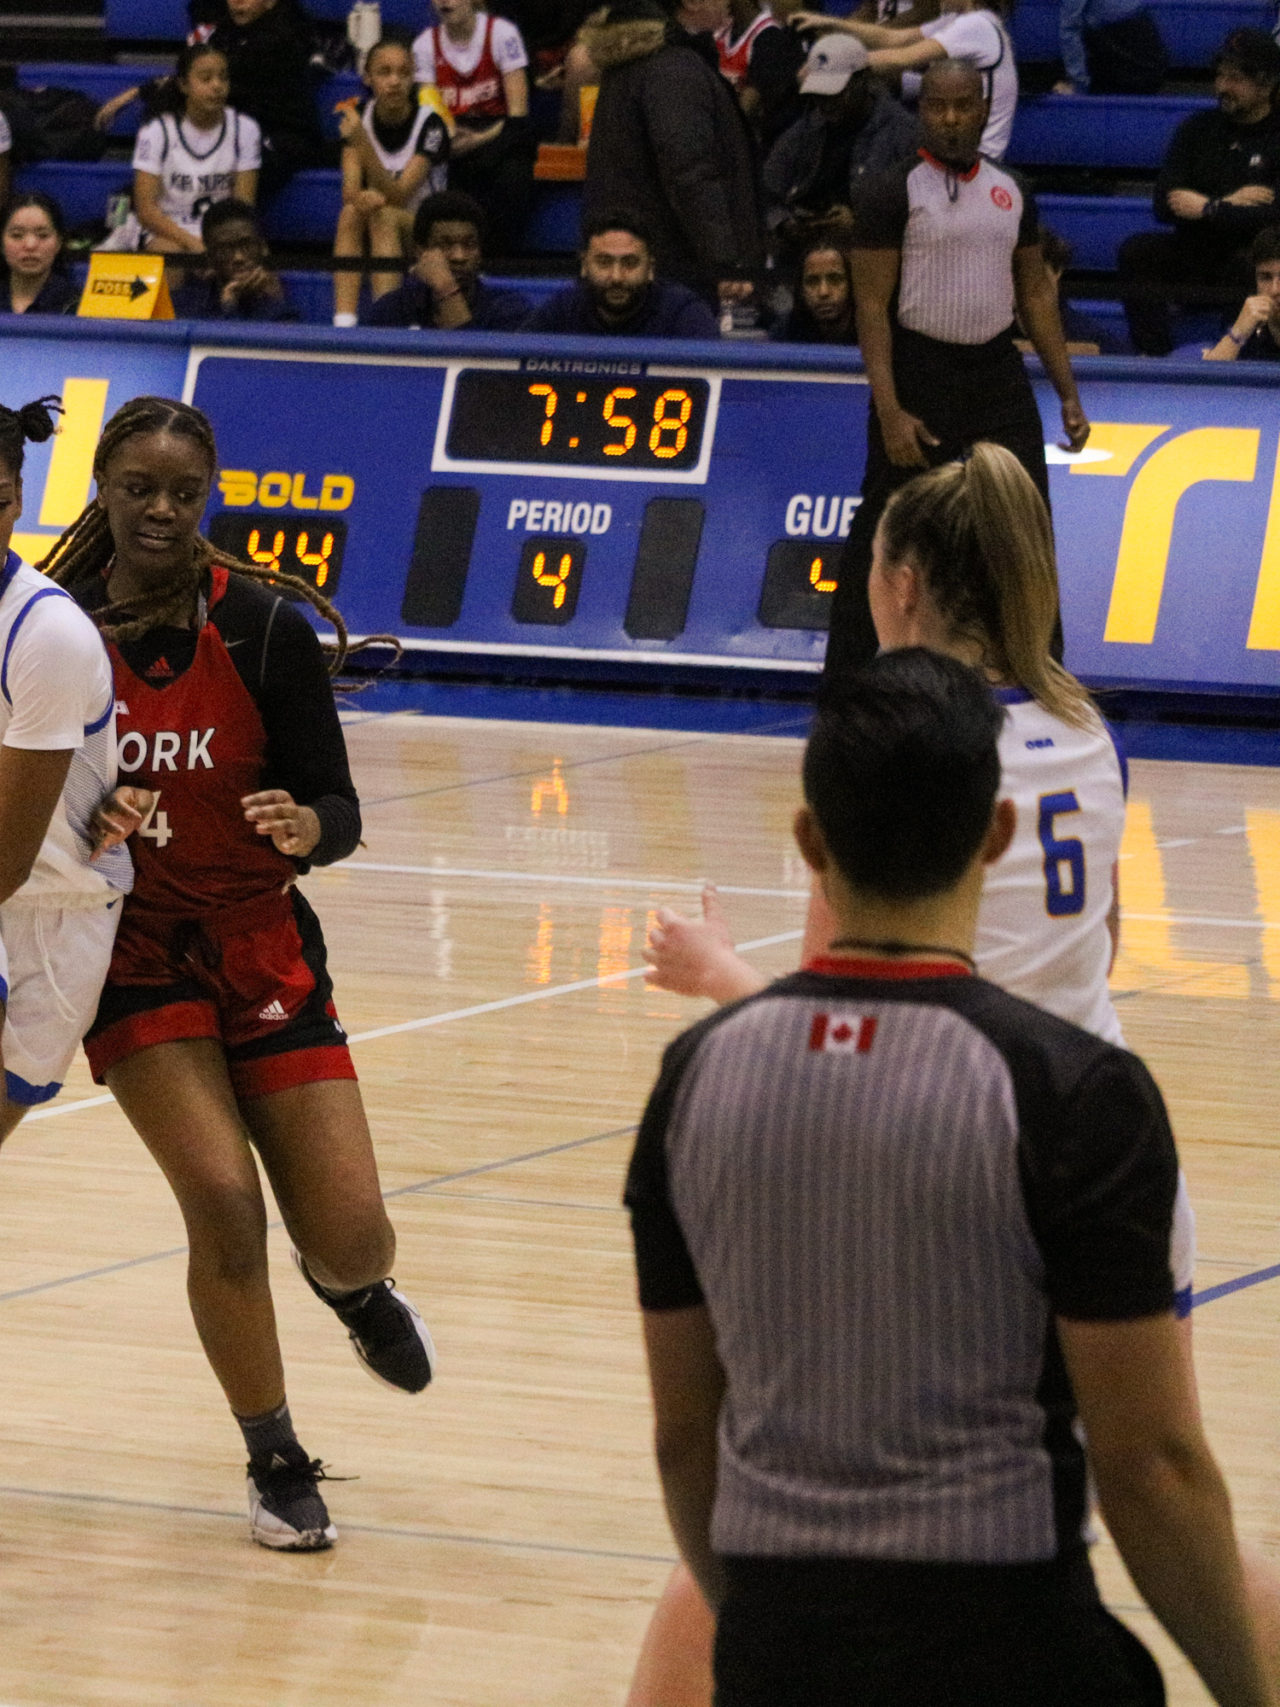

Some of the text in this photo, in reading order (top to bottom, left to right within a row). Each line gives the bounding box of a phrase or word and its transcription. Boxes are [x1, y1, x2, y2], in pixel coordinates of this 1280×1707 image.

[526, 360, 641, 375] DAKTRONICS
[528, 384, 692, 459] 7:58
[218, 470, 355, 511] BOLD
[507, 499, 612, 534] PERIOD
[785, 493, 864, 537] GUE
[247, 529, 334, 587] 44
[532, 552, 572, 609] 4
[117, 727, 216, 773] ORK
[1036, 787, 1086, 920] 6
